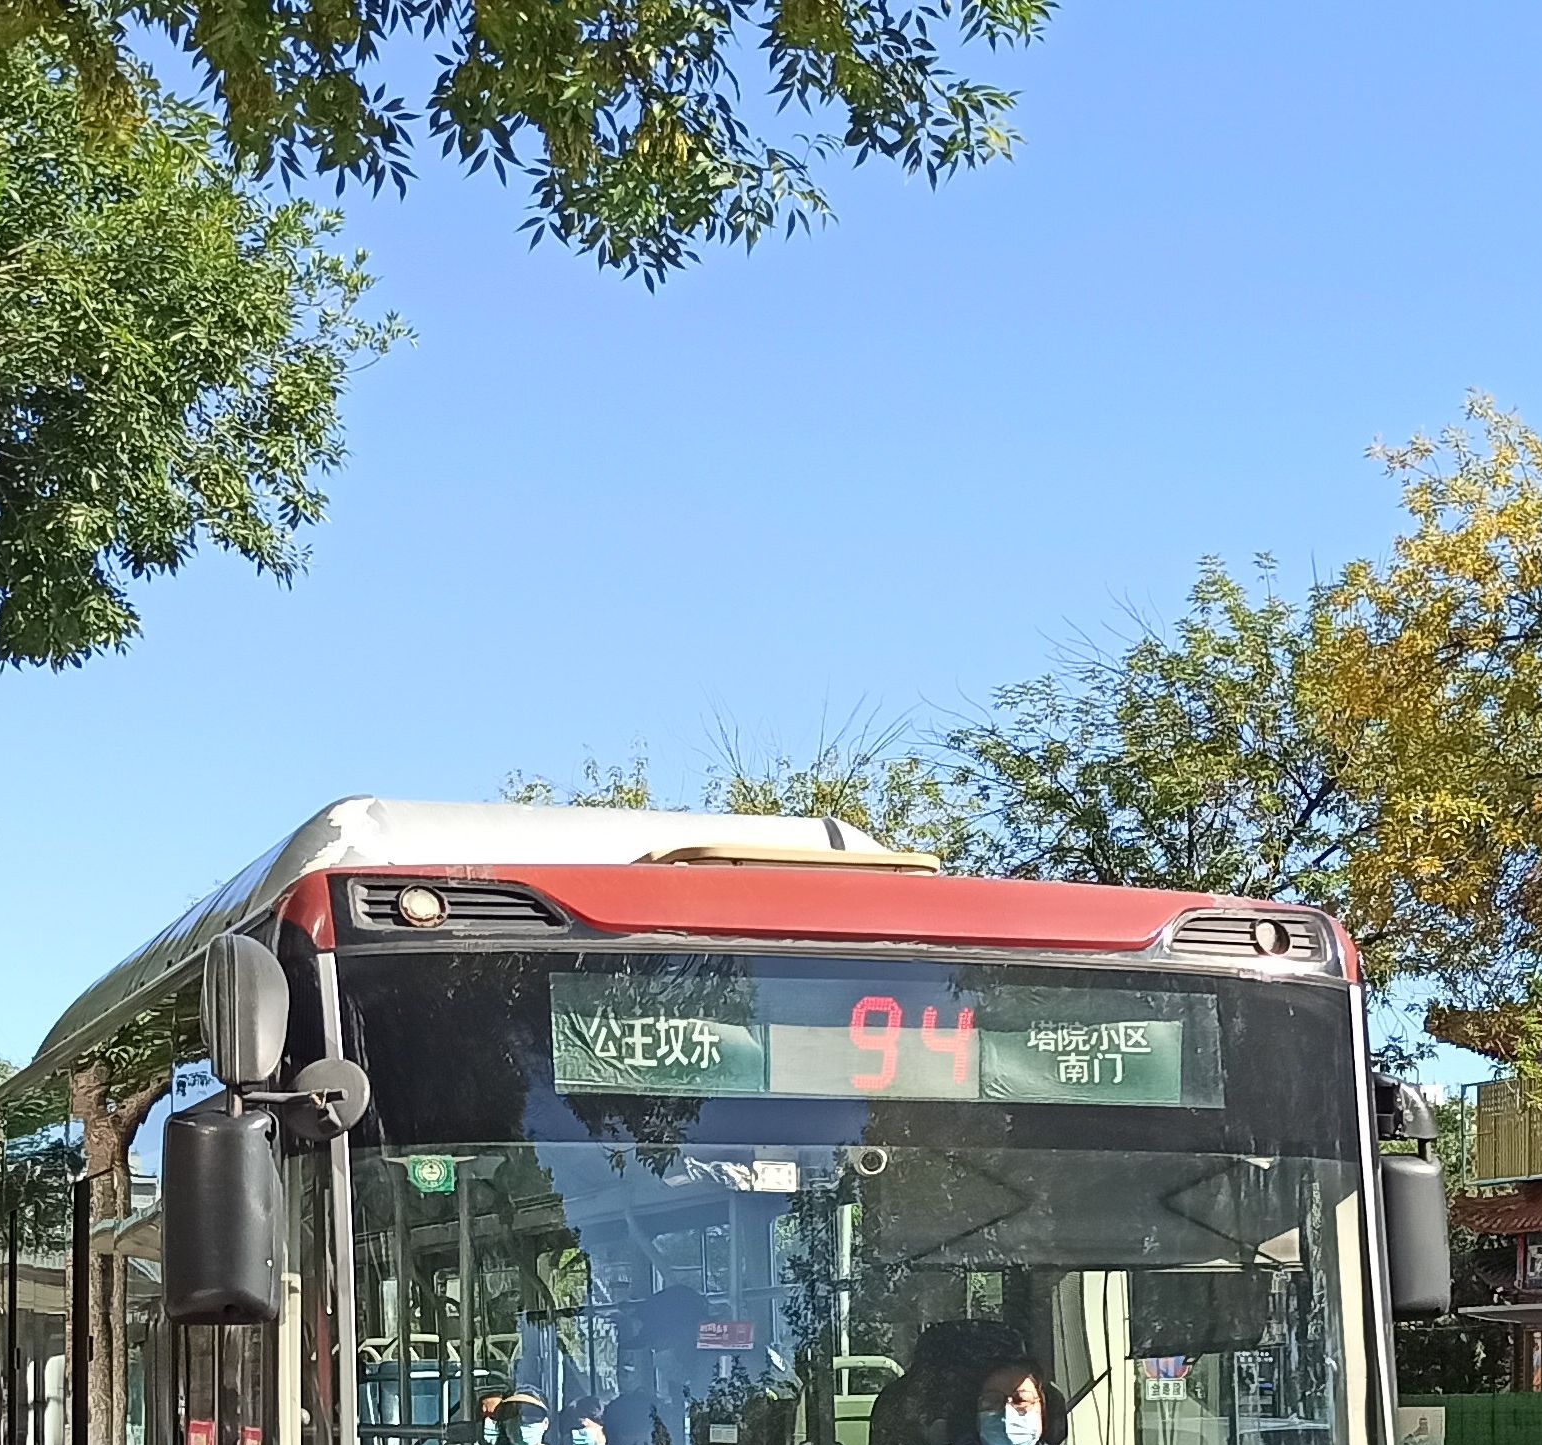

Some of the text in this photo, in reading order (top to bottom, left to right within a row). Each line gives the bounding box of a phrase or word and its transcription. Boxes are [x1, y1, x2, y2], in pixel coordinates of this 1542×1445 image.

[850, 996, 975, 1090] 94
[1027, 1019, 1151, 1053] 塔院小区
[1056, 1052, 1126, 1084] 南门
